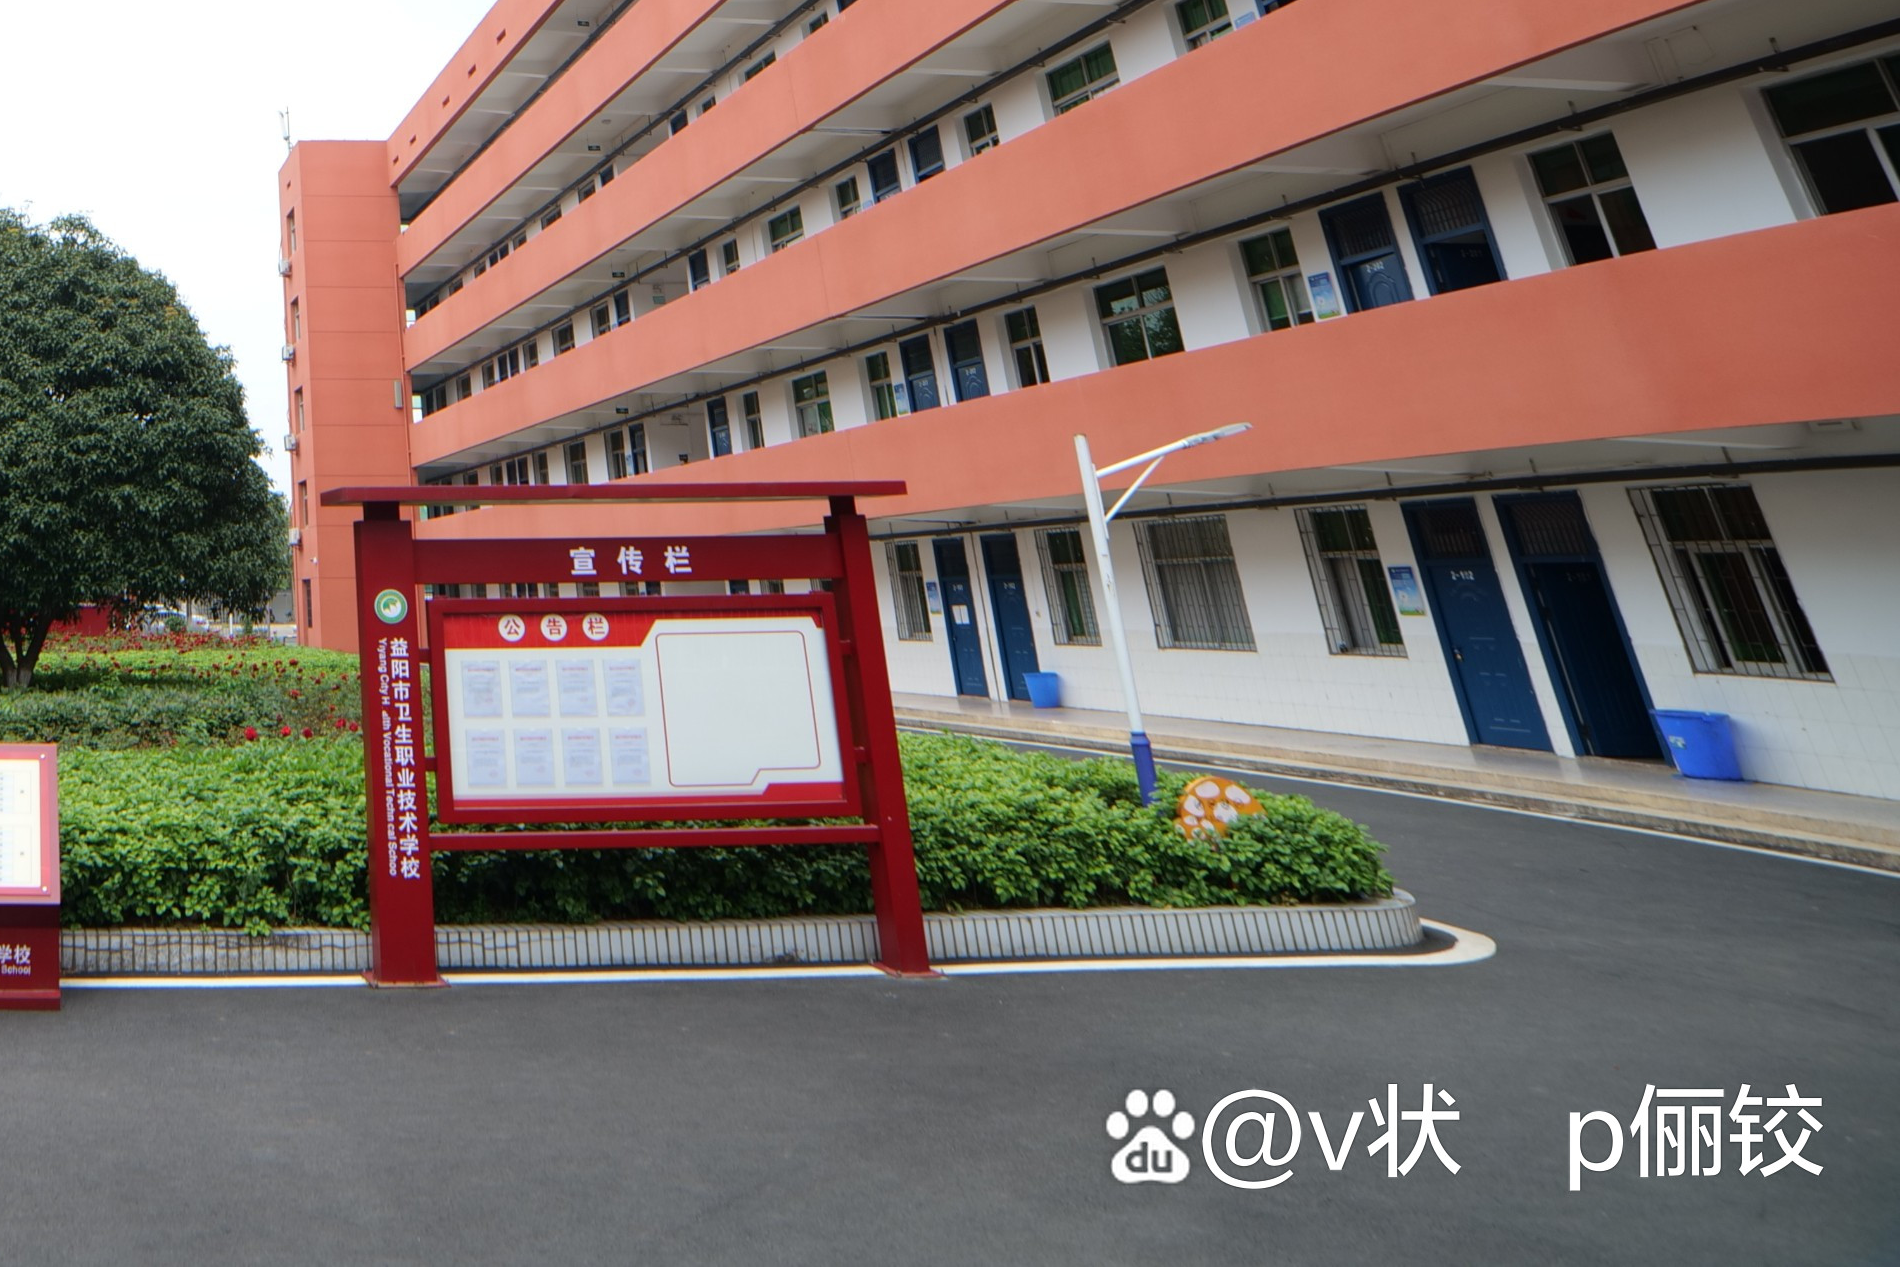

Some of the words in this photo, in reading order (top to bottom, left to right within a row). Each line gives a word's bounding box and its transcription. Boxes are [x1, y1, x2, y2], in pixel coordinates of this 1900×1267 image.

[569, 546, 692, 575] 宣传栏
[503, 617, 606, 636] 公告栏
[383, 732, 394, 787] Vocational
[390, 637, 421, 879] 益阳市卫生职业技术学校
[386, 788, 396, 840] Techncal
[1, 964, 32, 976] School
